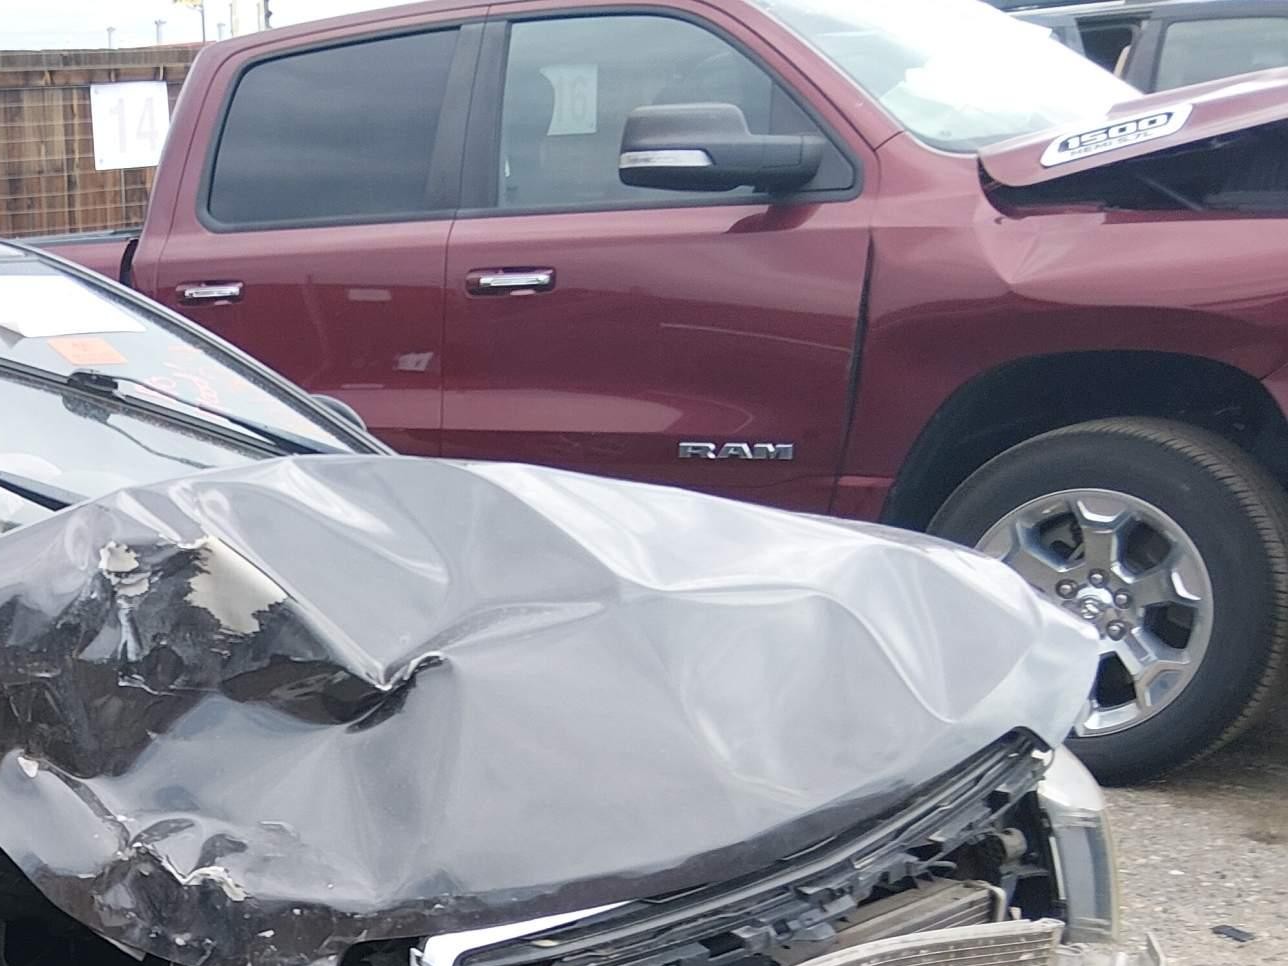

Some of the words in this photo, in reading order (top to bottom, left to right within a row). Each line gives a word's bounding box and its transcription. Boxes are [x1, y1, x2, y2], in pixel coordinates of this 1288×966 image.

[109, 97, 159, 153] 14
[1061, 112, 1173, 152] 1500
[678, 442, 793, 460] RAM
